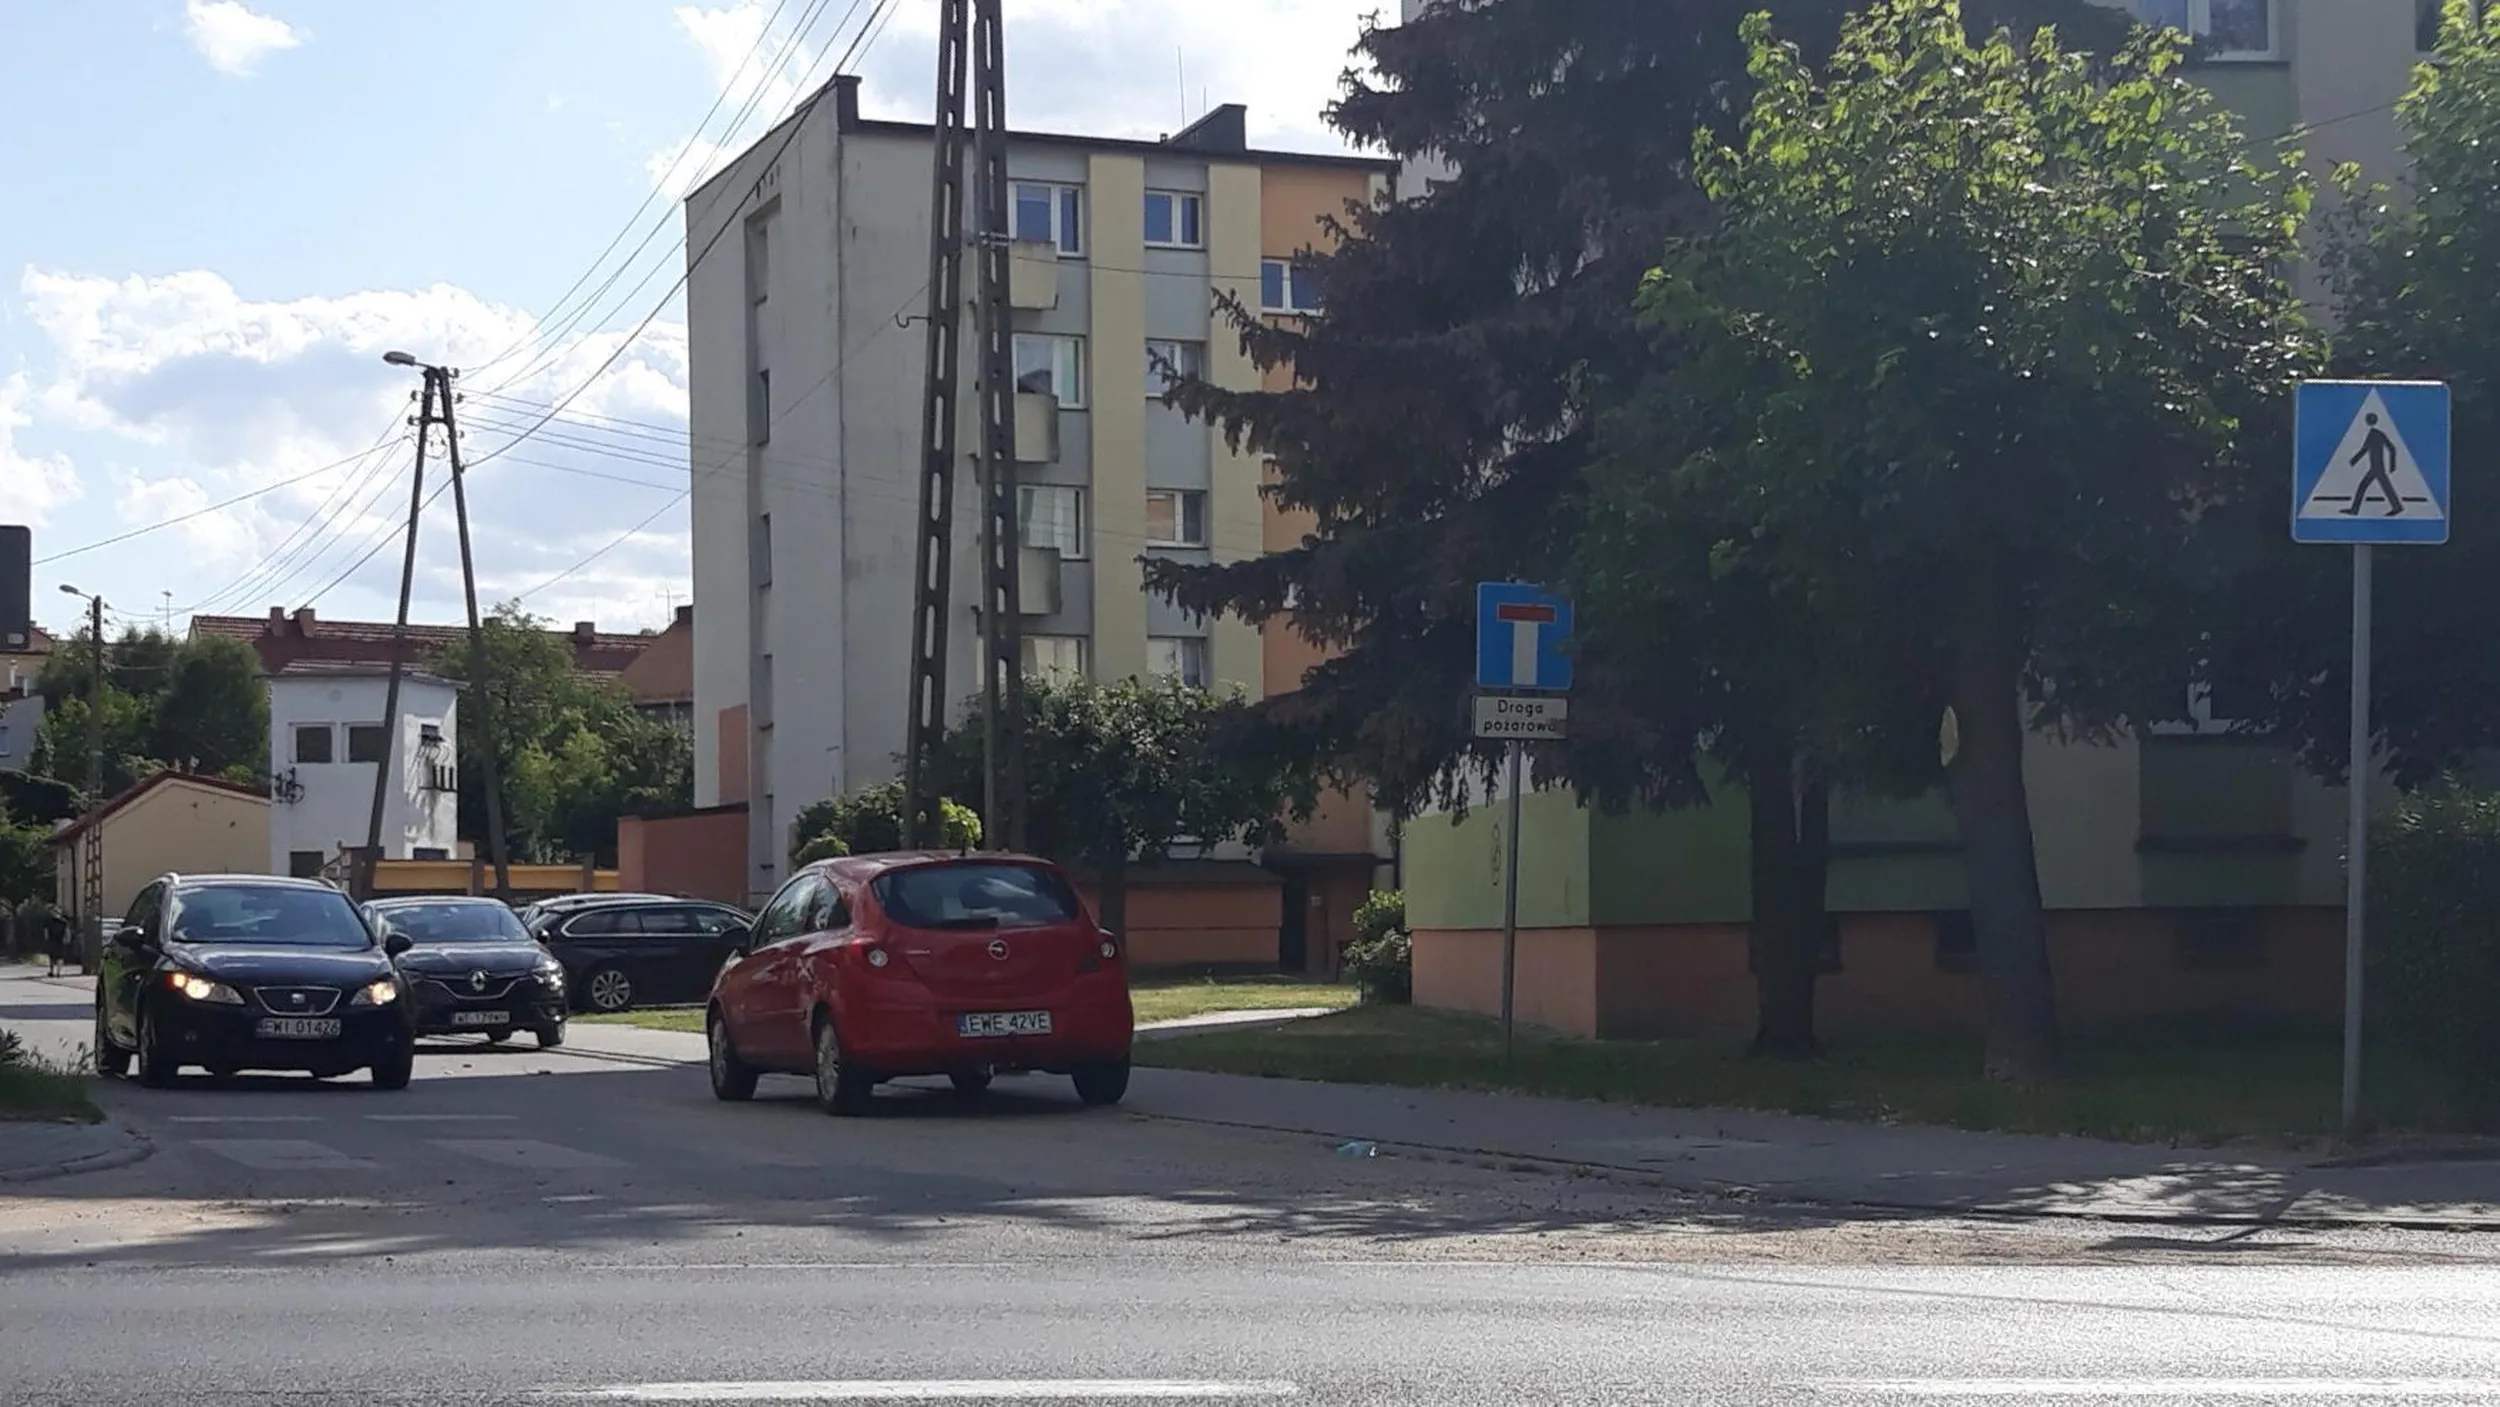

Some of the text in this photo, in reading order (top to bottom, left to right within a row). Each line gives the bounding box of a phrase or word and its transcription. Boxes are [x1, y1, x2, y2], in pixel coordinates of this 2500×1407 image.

[1498, 699, 1543, 717] Droga
[969, 1012, 1048, 1032] EWE 42VE
